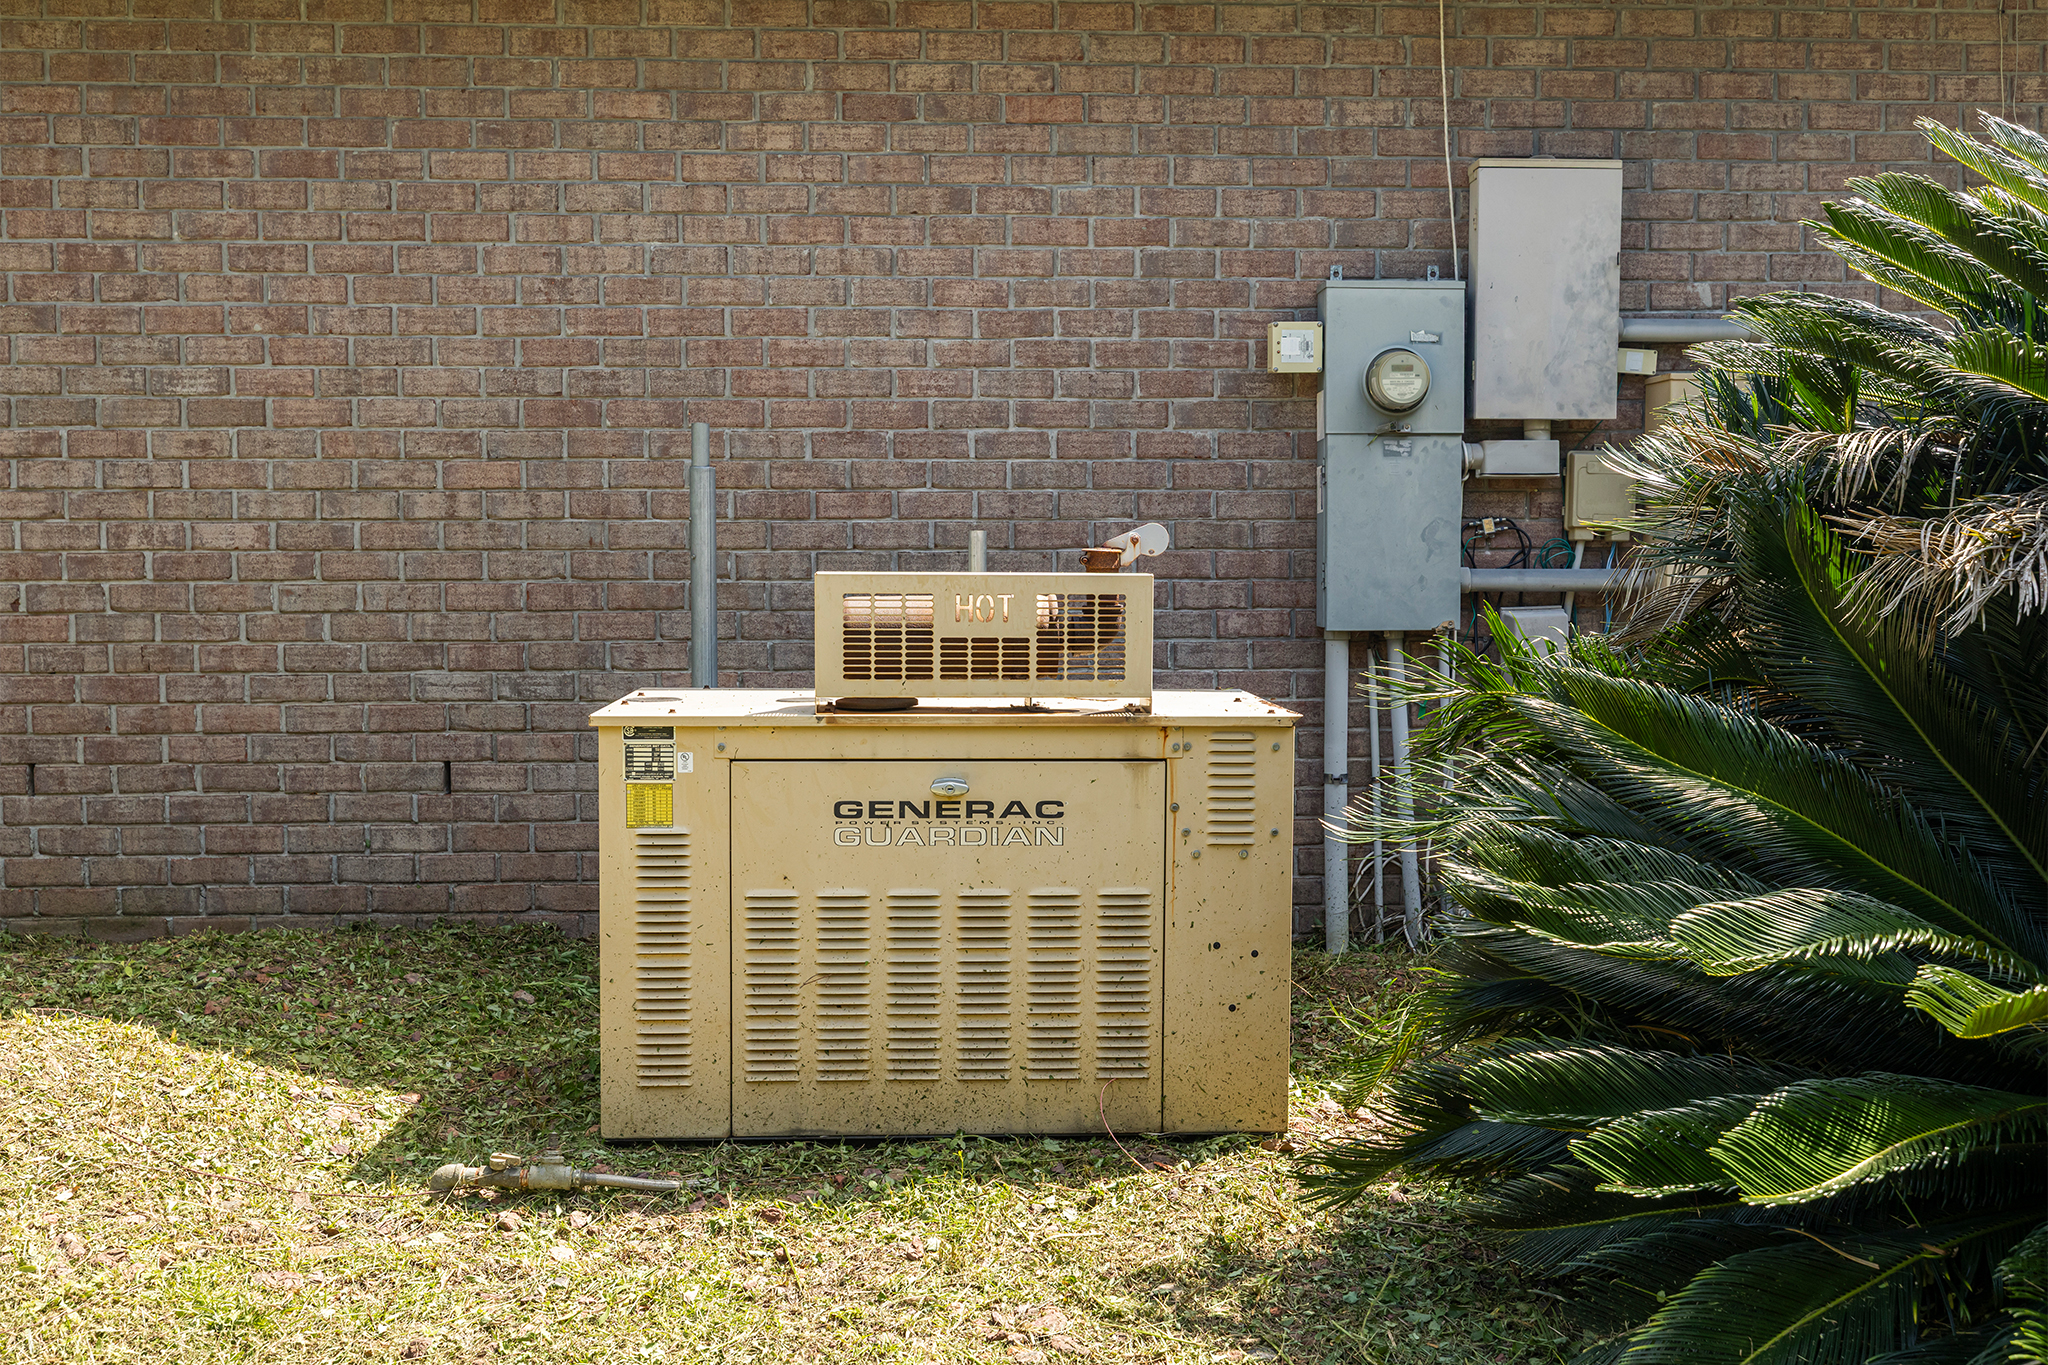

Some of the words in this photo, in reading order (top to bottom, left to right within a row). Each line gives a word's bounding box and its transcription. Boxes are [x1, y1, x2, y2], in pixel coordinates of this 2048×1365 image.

[955, 593, 1015, 623] HOT
[833, 800, 1065, 819] GENERAC
[833, 826, 1064, 847] GUARDIAN
